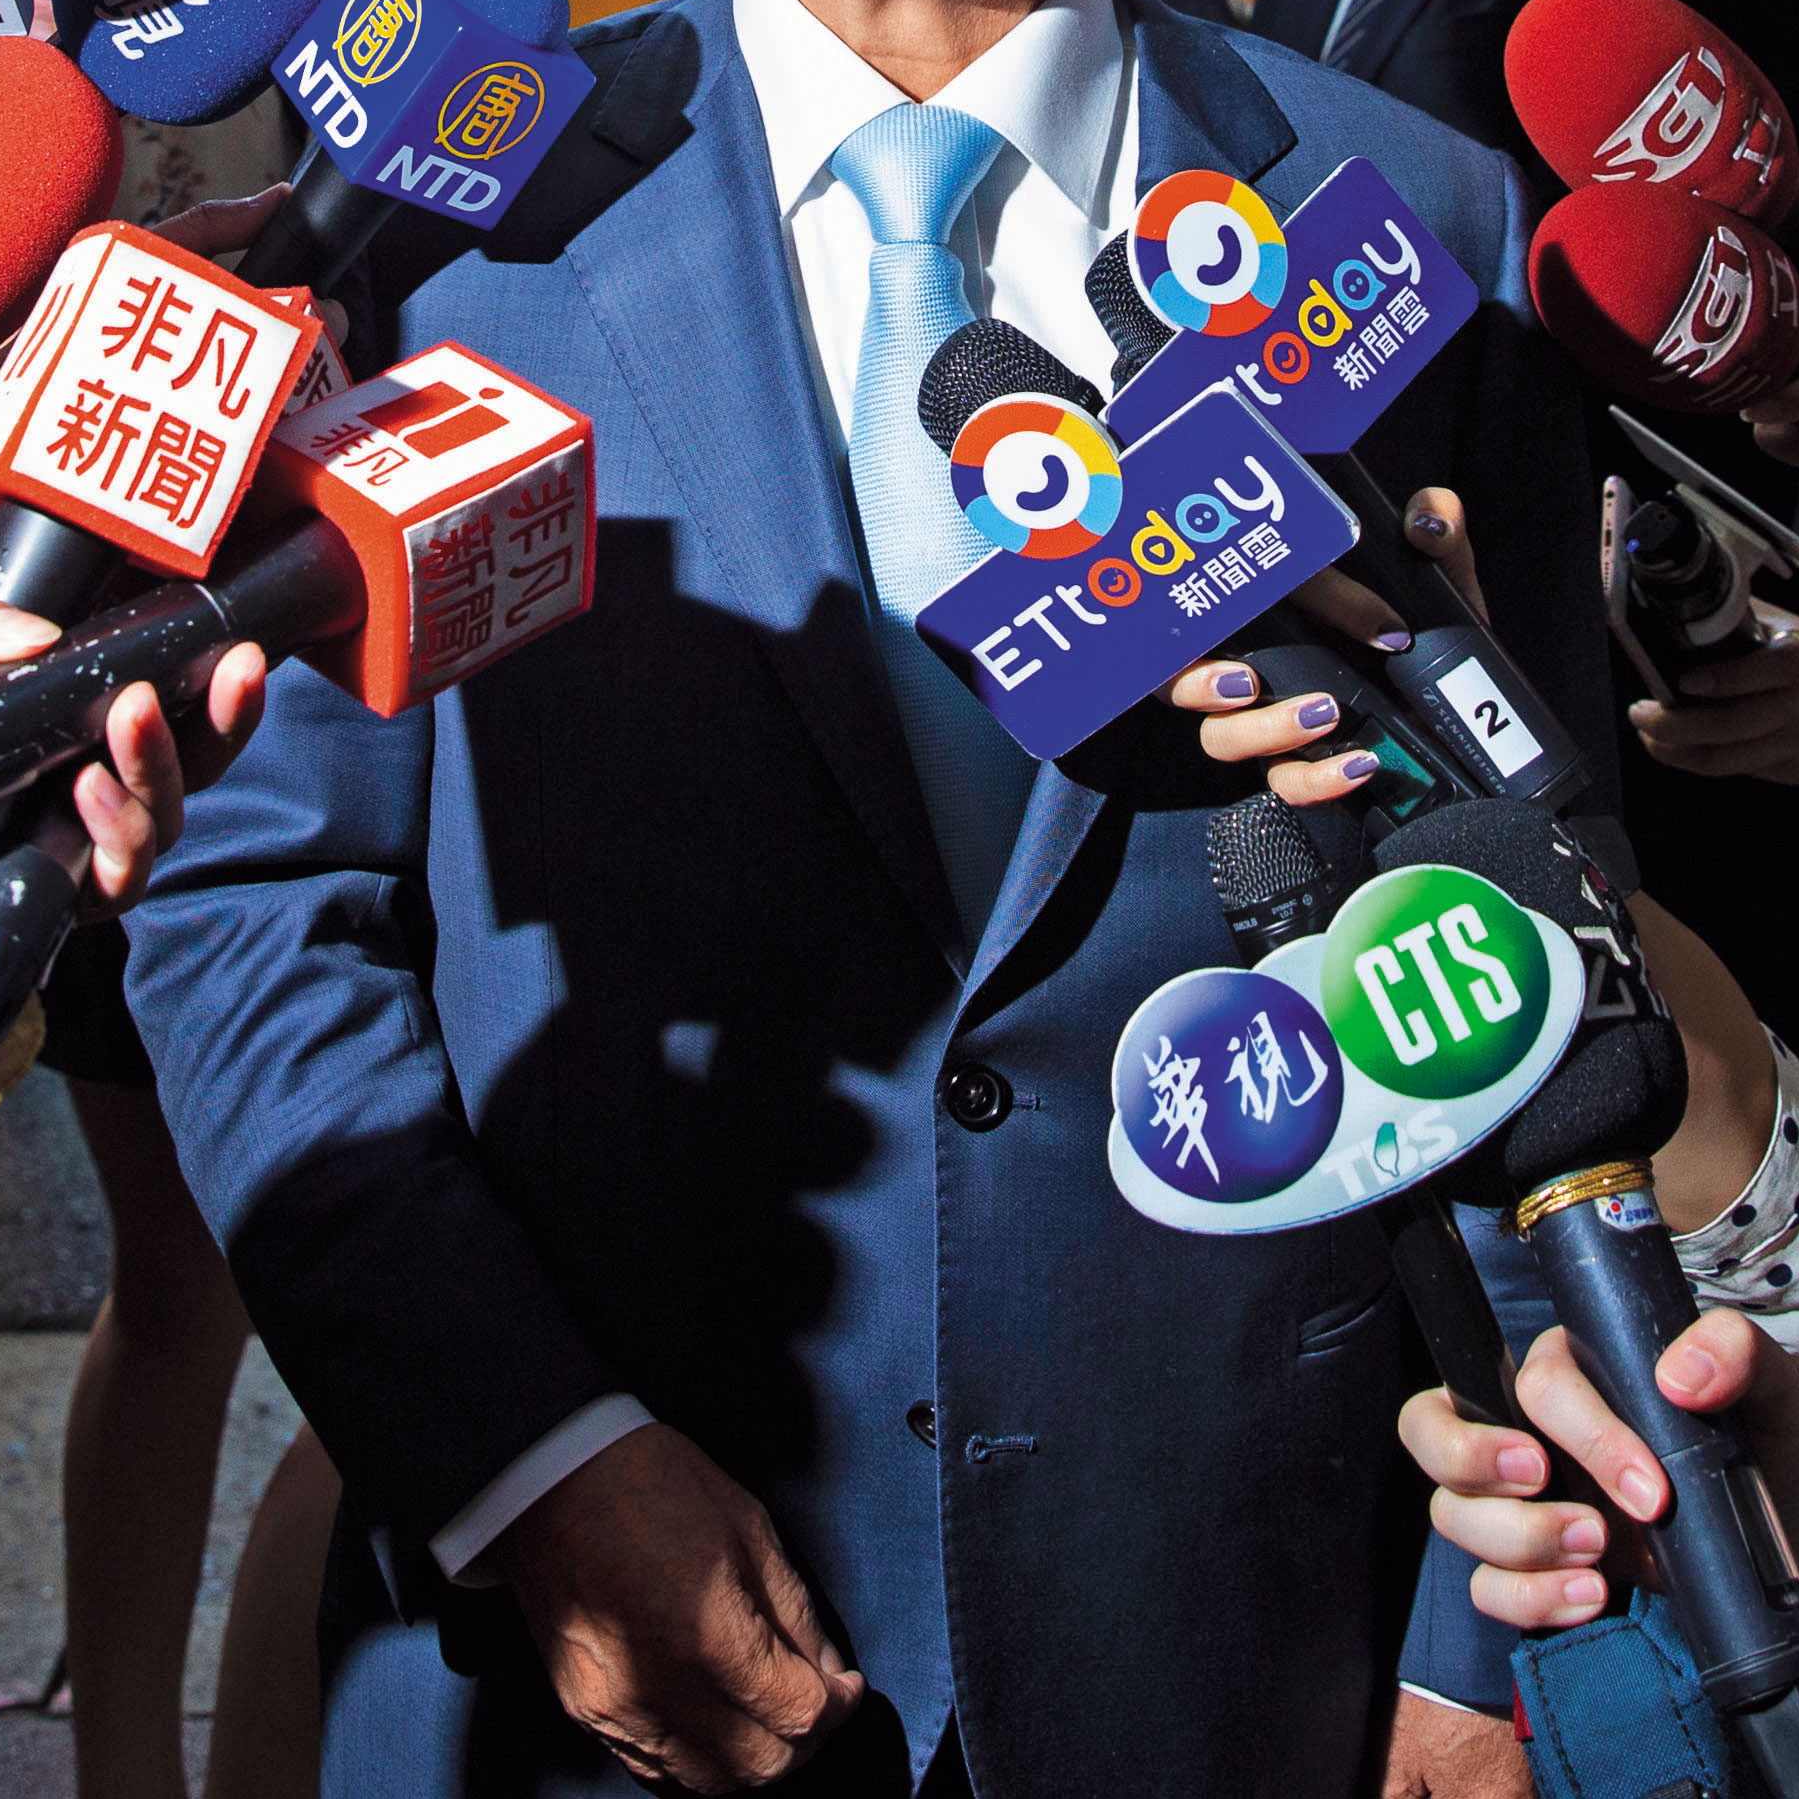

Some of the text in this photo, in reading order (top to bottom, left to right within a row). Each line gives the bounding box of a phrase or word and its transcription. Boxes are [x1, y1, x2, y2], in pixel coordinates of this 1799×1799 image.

[284, 40, 368, 149] NTD
[376, 144, 501, 213] NTD
[101, 275, 259, 421] 非凡
[1225, 218, 1422, 406] today
[1332, 285, 1431, 391] 新聞雲
[46, 377, 227, 530] 新聞
[312, 422, 411, 488] 非凡
[971, 454, 1287, 693] ETtoday
[1168, 521, 1293, 620] 新聞雲
[1475, 700, 1511, 739] 2
[1354, 903, 1523, 1067] CTS
